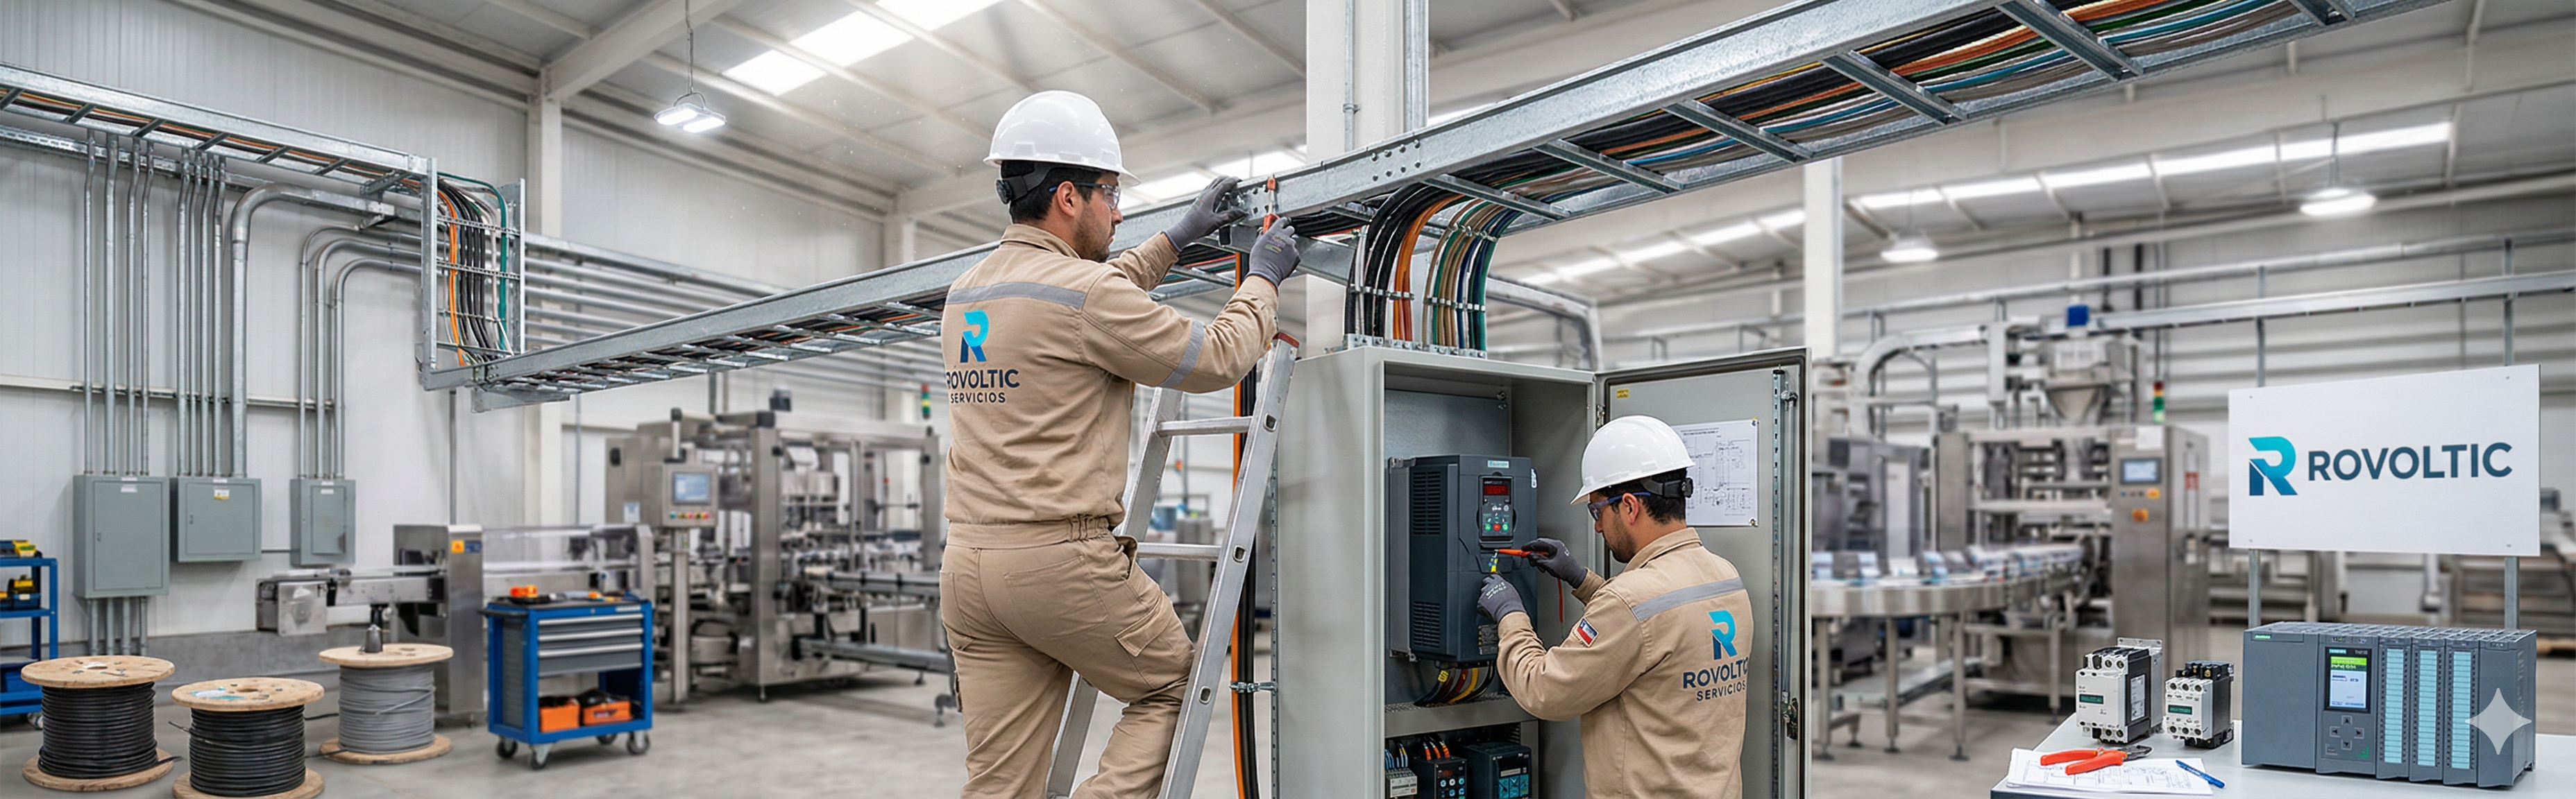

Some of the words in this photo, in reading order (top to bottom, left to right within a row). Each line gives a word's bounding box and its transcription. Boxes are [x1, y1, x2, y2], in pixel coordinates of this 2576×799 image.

[951, 392, 1006, 404] SERVICIOS
[2308, 442, 2513, 481] ROVOLTIC
[1696, 680, 1746, 701] SERVICIOS
